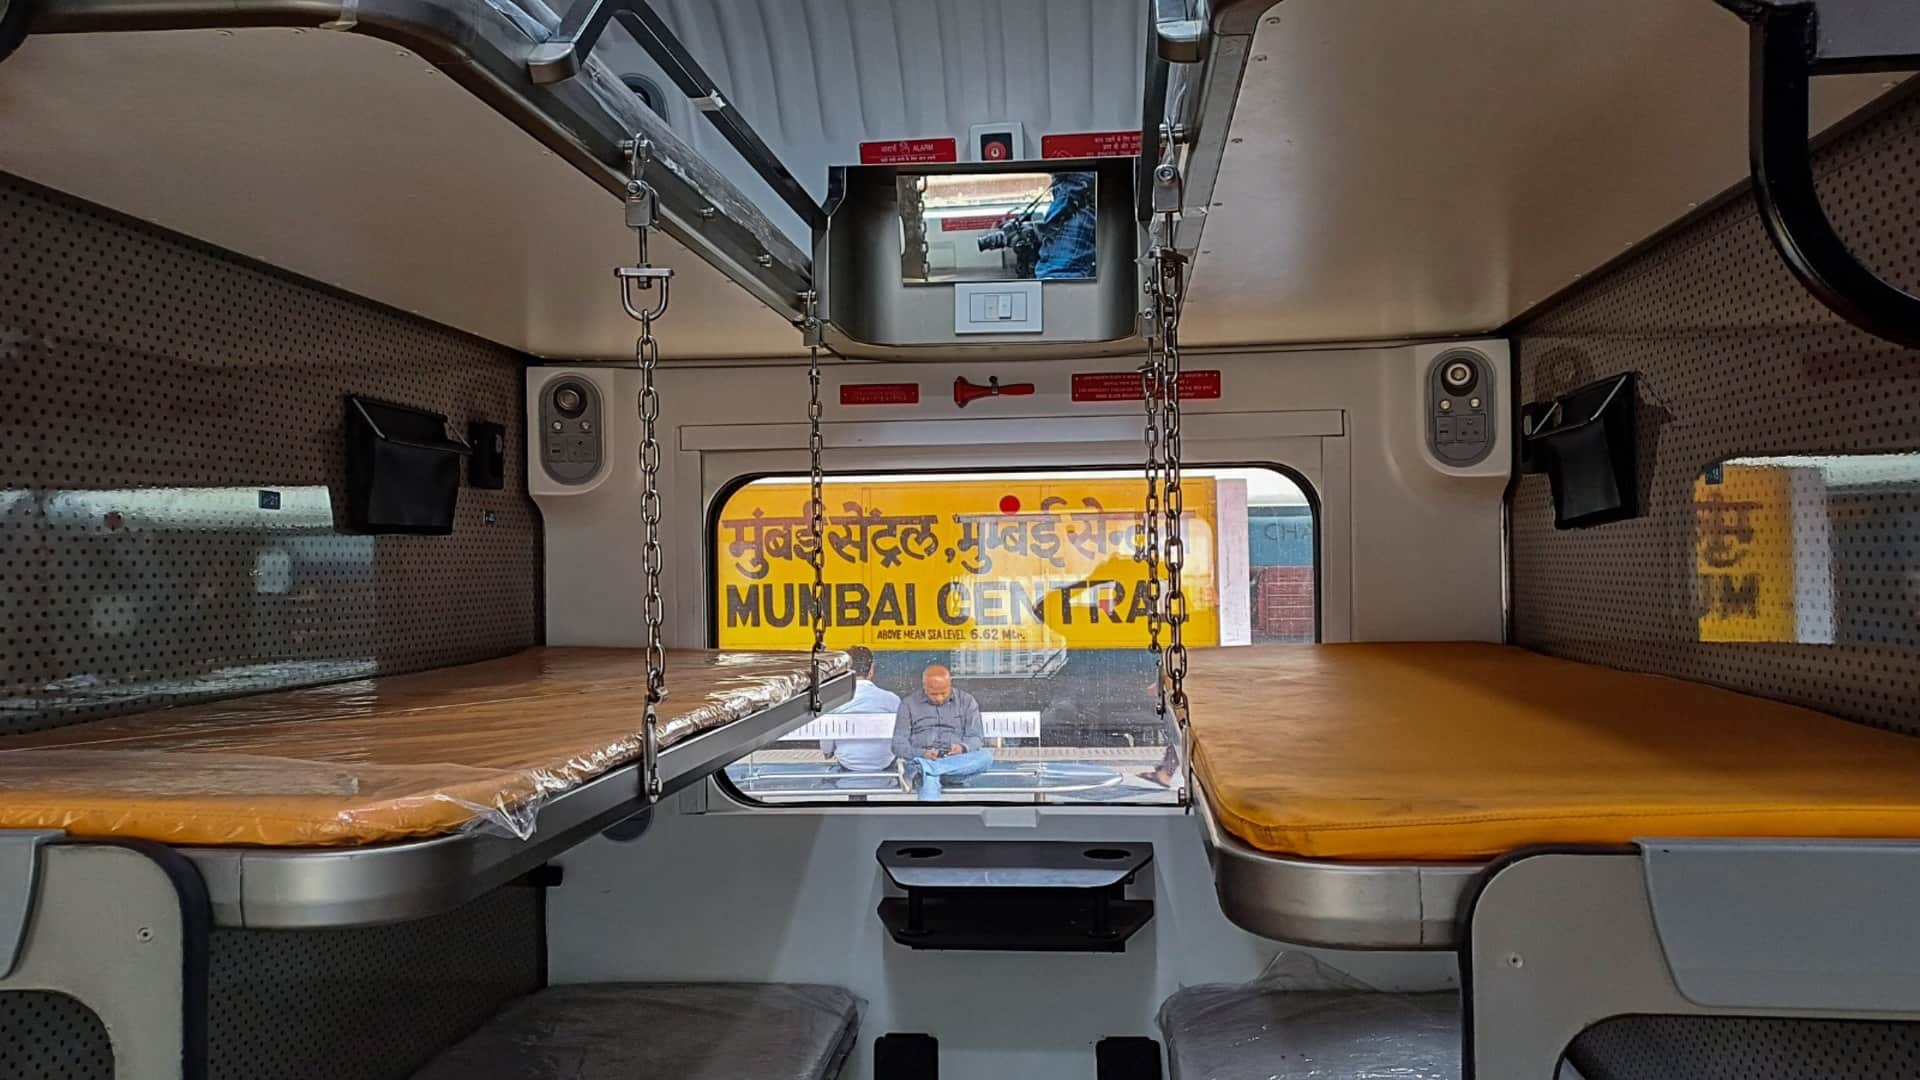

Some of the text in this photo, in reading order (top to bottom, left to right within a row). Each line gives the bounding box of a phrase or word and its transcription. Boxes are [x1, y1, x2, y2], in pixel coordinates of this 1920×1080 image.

[912, 143, 934, 153] ALARM
[726, 582, 917, 628] MUMBAI
[876, 628, 901, 641] ABOVE
[903, 628, 926, 641] MEAN
[927, 628, 942, 641] SEA
[943, 628, 967, 641] LEVEL
[970, 628, 999, 641] 6.62
